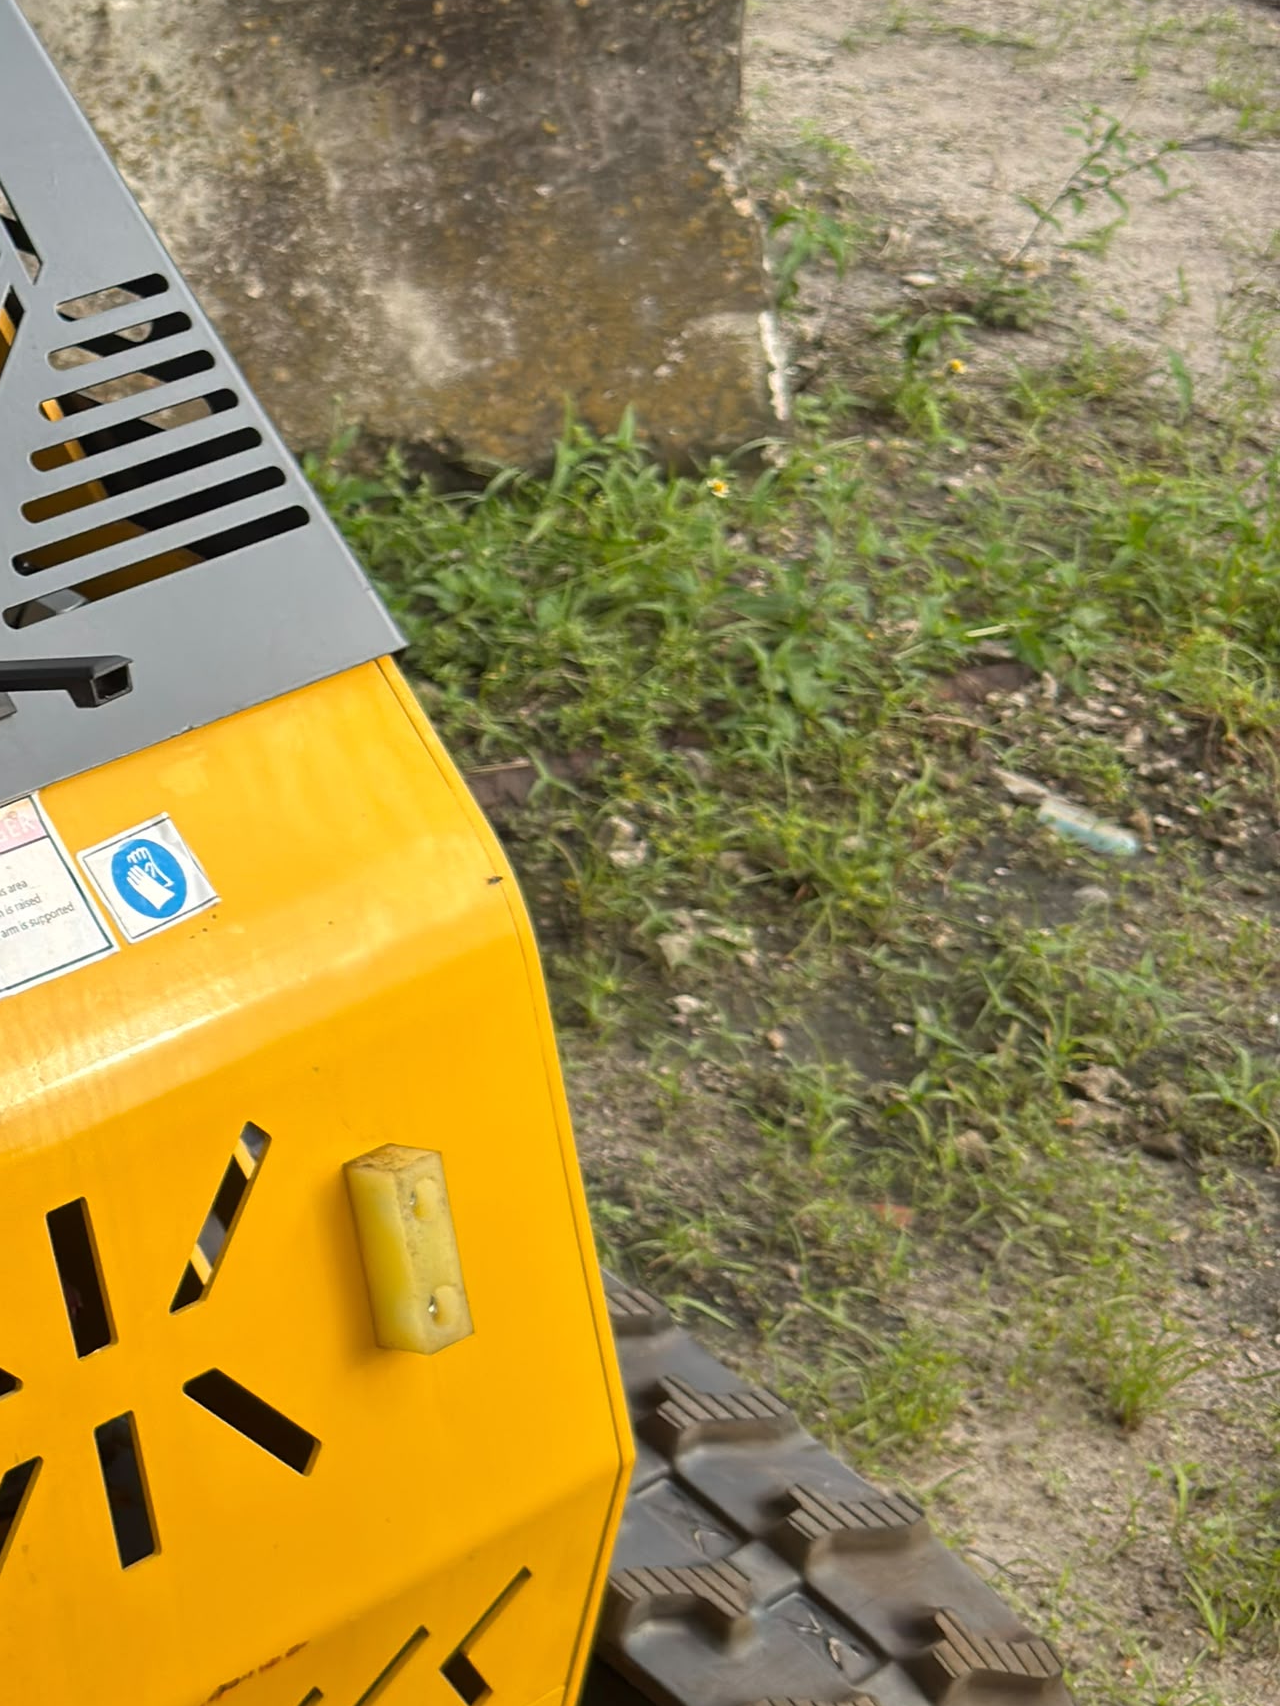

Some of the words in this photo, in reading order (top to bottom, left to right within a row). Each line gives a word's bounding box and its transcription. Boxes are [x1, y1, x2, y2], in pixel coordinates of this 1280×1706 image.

[8, 880, 28, 894] area
[5, 904, 14, 916] is
[16, 893, 43, 912] raised
[1, 923, 20, 939] arm
[20, 919, 29, 930] is
[29, 901, 76, 928] supported
